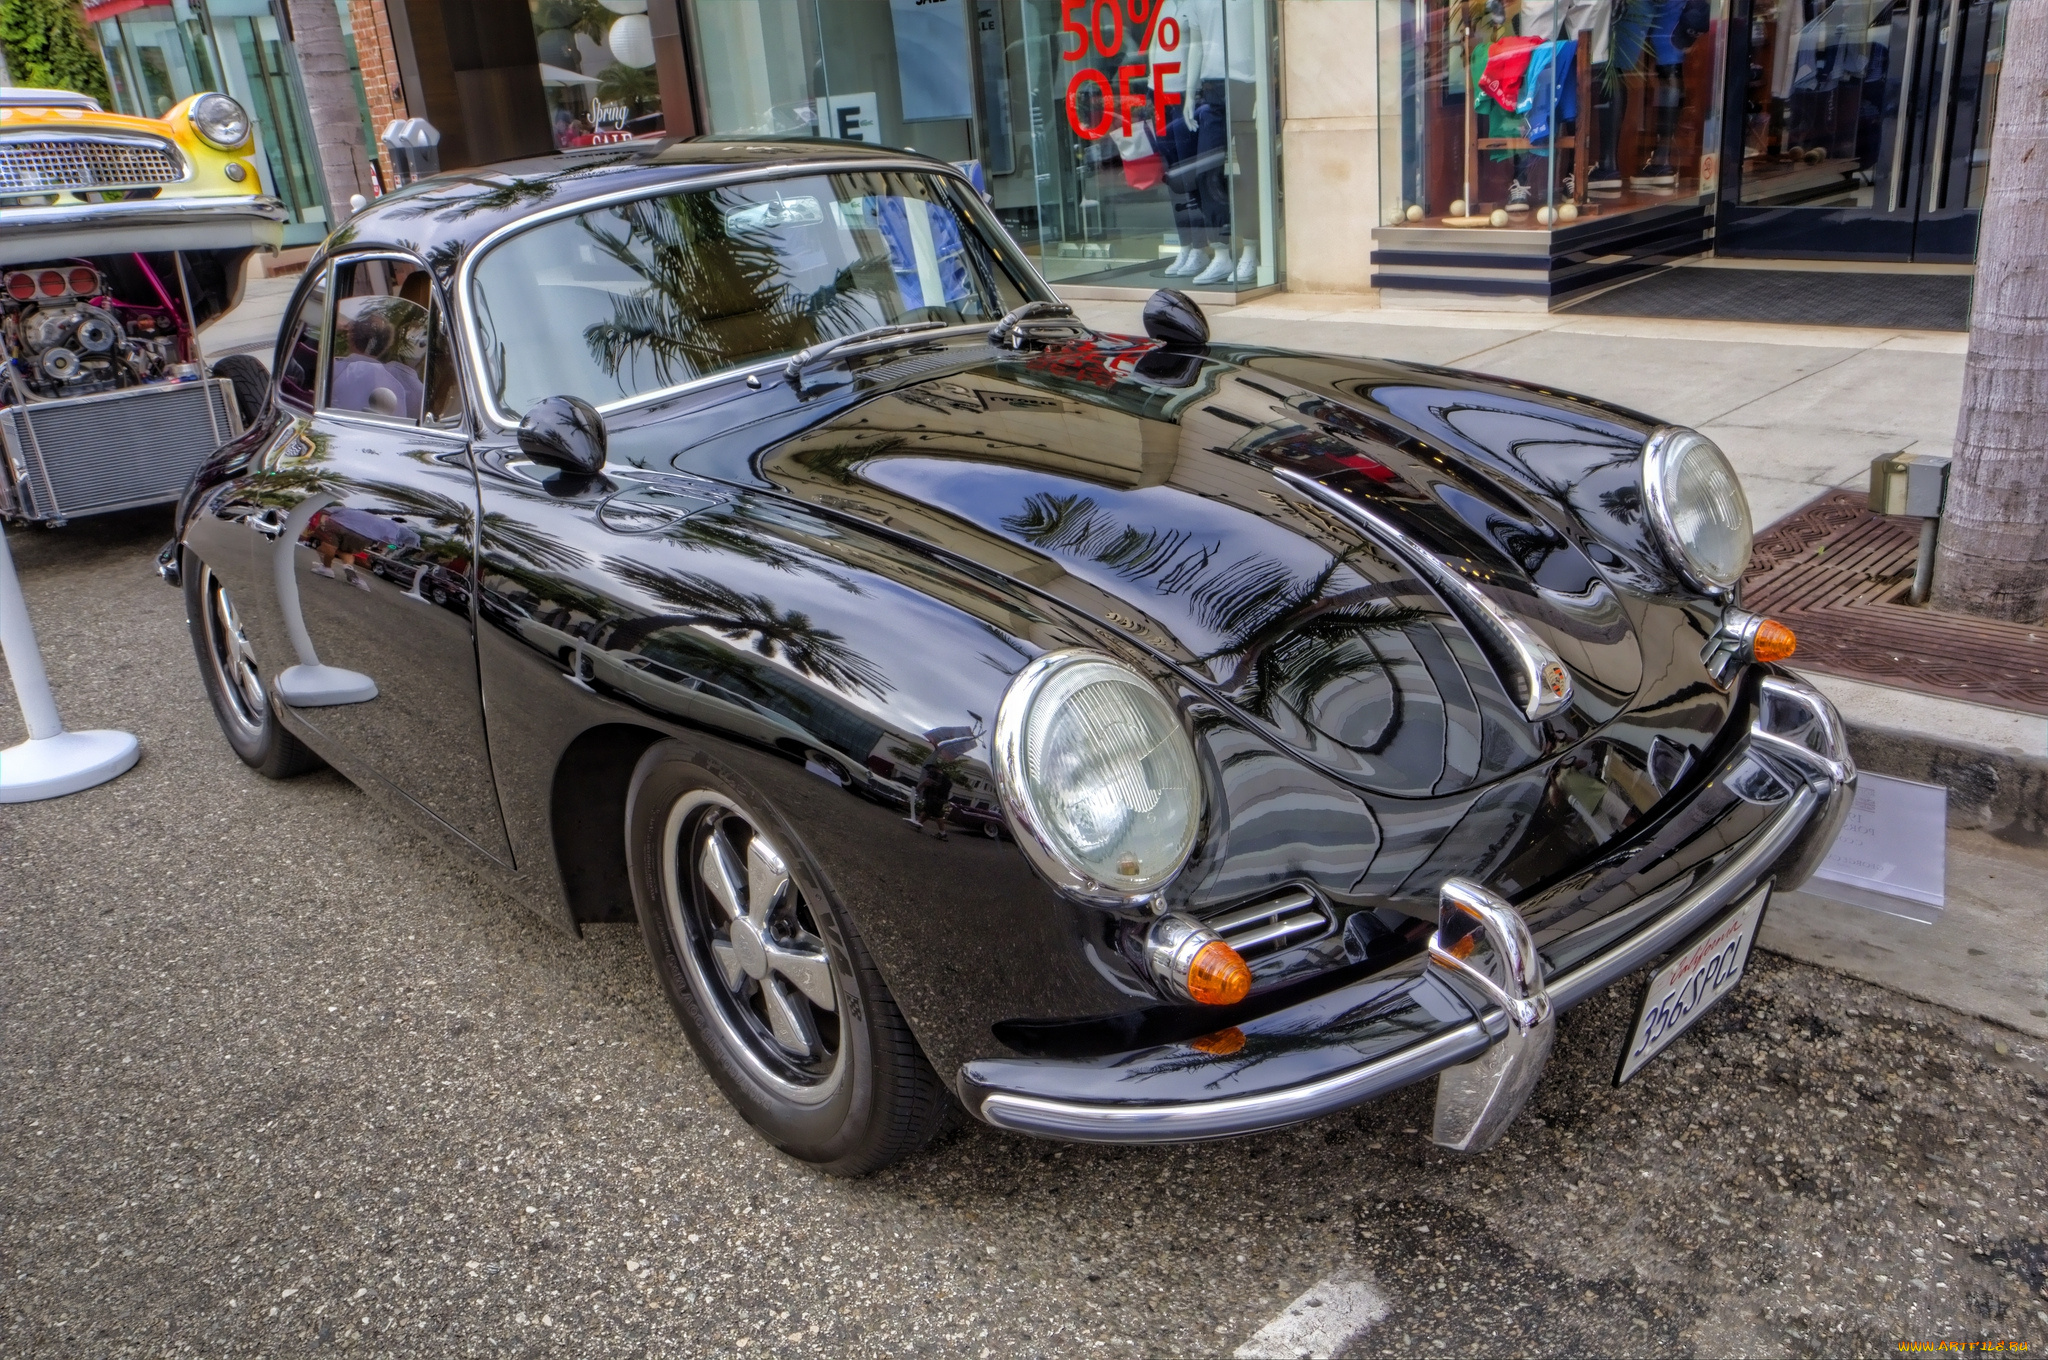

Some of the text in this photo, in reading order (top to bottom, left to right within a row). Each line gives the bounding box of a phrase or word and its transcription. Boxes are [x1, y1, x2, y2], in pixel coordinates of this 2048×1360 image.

[1061, 0, 1180, 62] 50%
[587, 97, 629, 133] Spring
[1065, 61, 1181, 140] OFF
[1669, 920, 1743, 987] California
[1634, 934, 1743, 1057] 356SPCL
